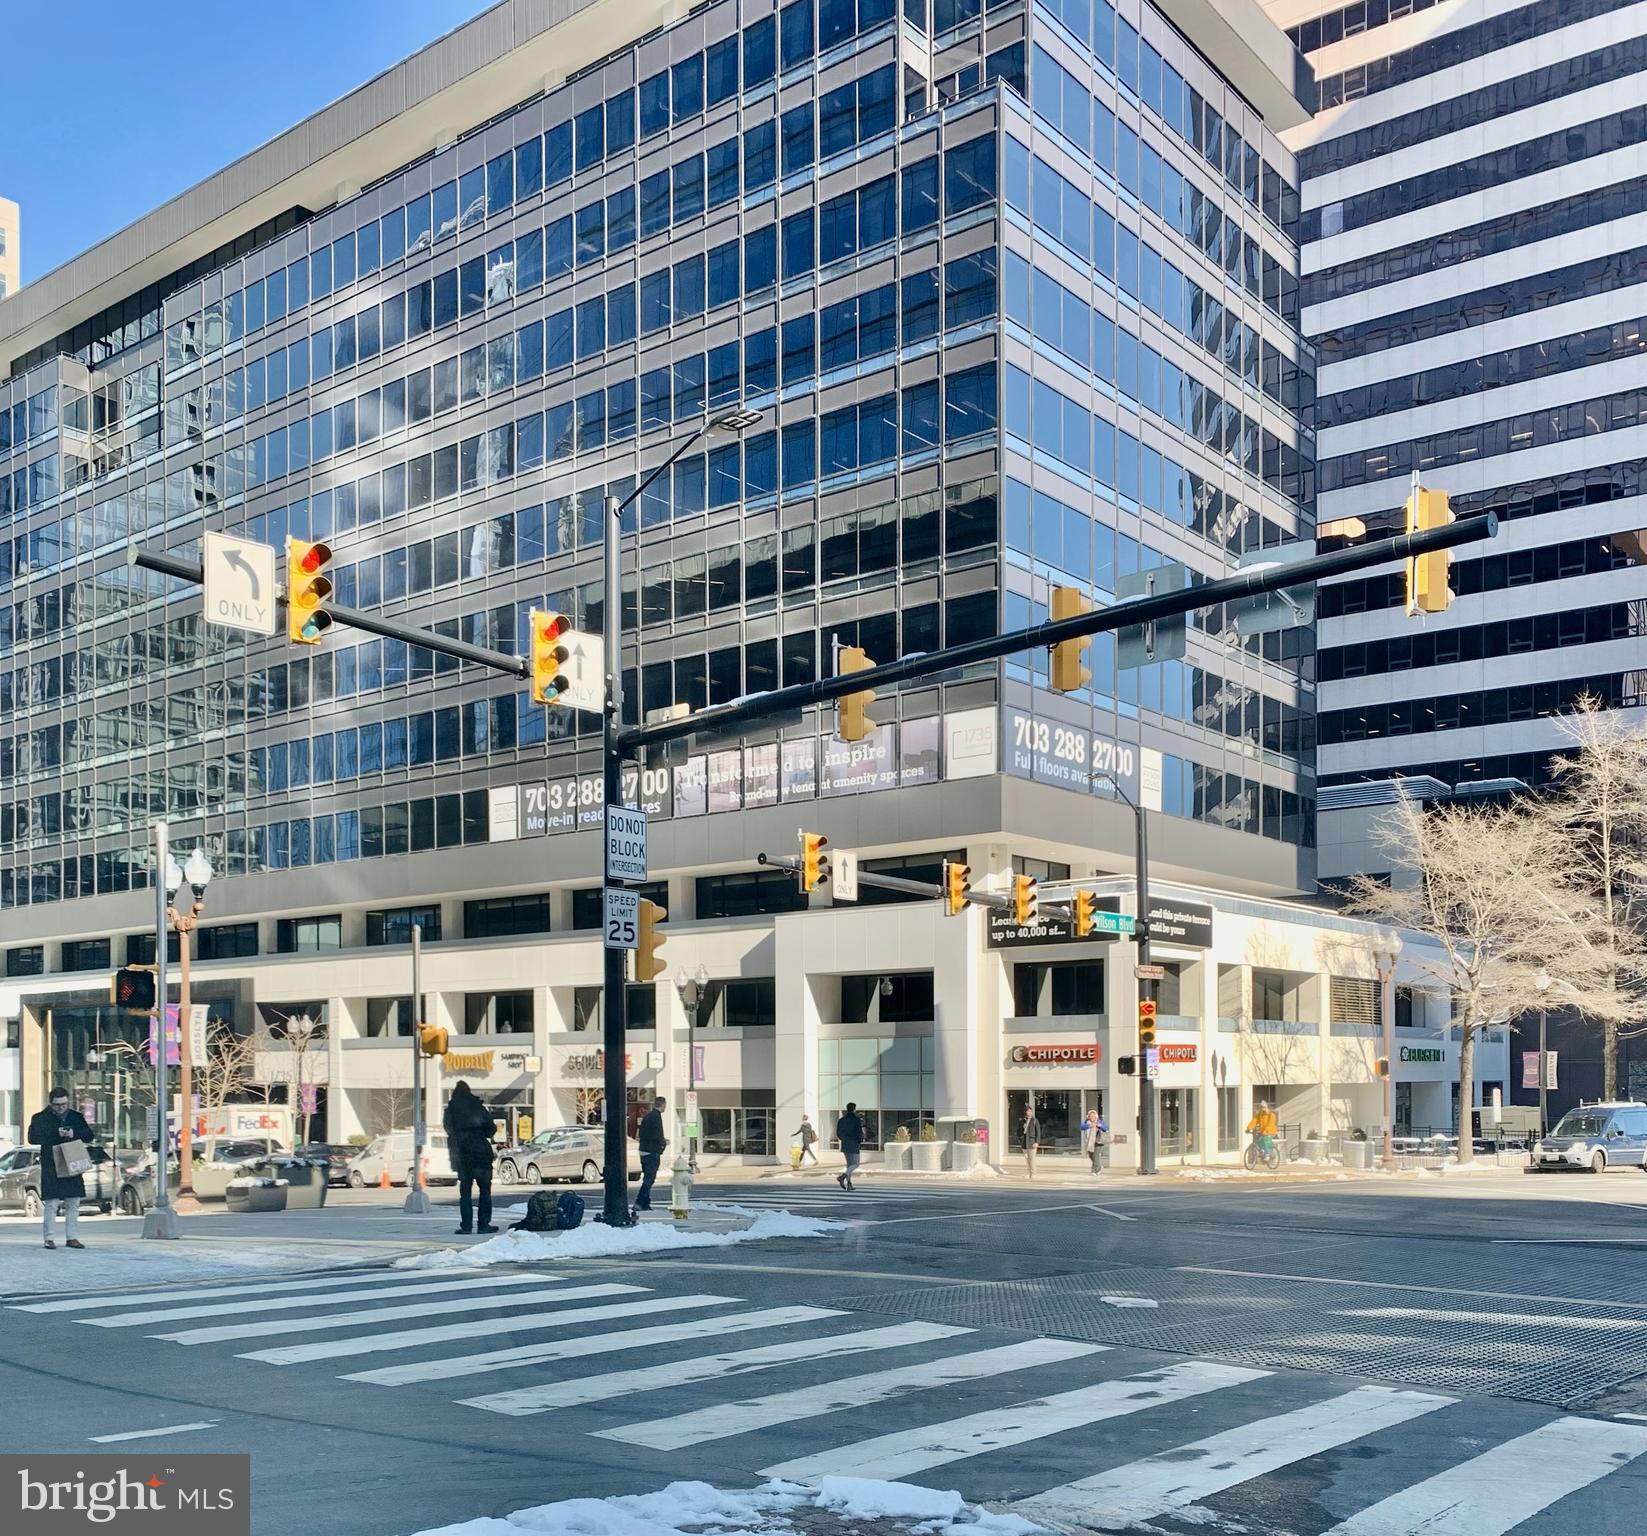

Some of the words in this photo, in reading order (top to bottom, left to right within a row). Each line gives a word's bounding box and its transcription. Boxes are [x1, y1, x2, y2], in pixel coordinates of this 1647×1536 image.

[219, 599, 266, 623] ONLY
[1013, 715, 1050, 754] 703
[1054, 728, 1085, 763] 288
[1092, 740, 1133, 776] 2700
[799, 756, 815, 771] to
[825, 743, 886, 769] inspire
[1014, 751, 1037, 772] Full
[1040, 756, 1069, 779] floors
[791, 779, 831, 794] tenant
[833, 773, 878, 791] amenity
[880, 765, 924, 783] spaces
[525, 784, 562, 813] 703
[567, 777, 604, 809] 288
[527, 811, 574, 831] Move-in
[577, 809, 604, 827] read
[610, 815, 625, 833] DO
[625, 818, 645, 837] NOT
[611, 838, 646, 859] BLOCK
[611, 859, 646, 875] INTERSECTION
[608, 894, 637, 907] SPEED
[611, 907, 634, 918] LIMIT
[608, 920, 636, 943] 25
[992, 932, 1005, 942] up
[1006, 929, 1016, 939] to
[1016, 926, 1047, 938] 40,000
[1119, 918, 1135, 931] Blvd
[443, 1049, 495, 1072] POTBELLY
[1028, 1047, 1095, 1060] CHIPOTLE
[1163, 1047, 1196, 1058] CHIPOTL
[237, 1115, 280, 1130] FedEx
